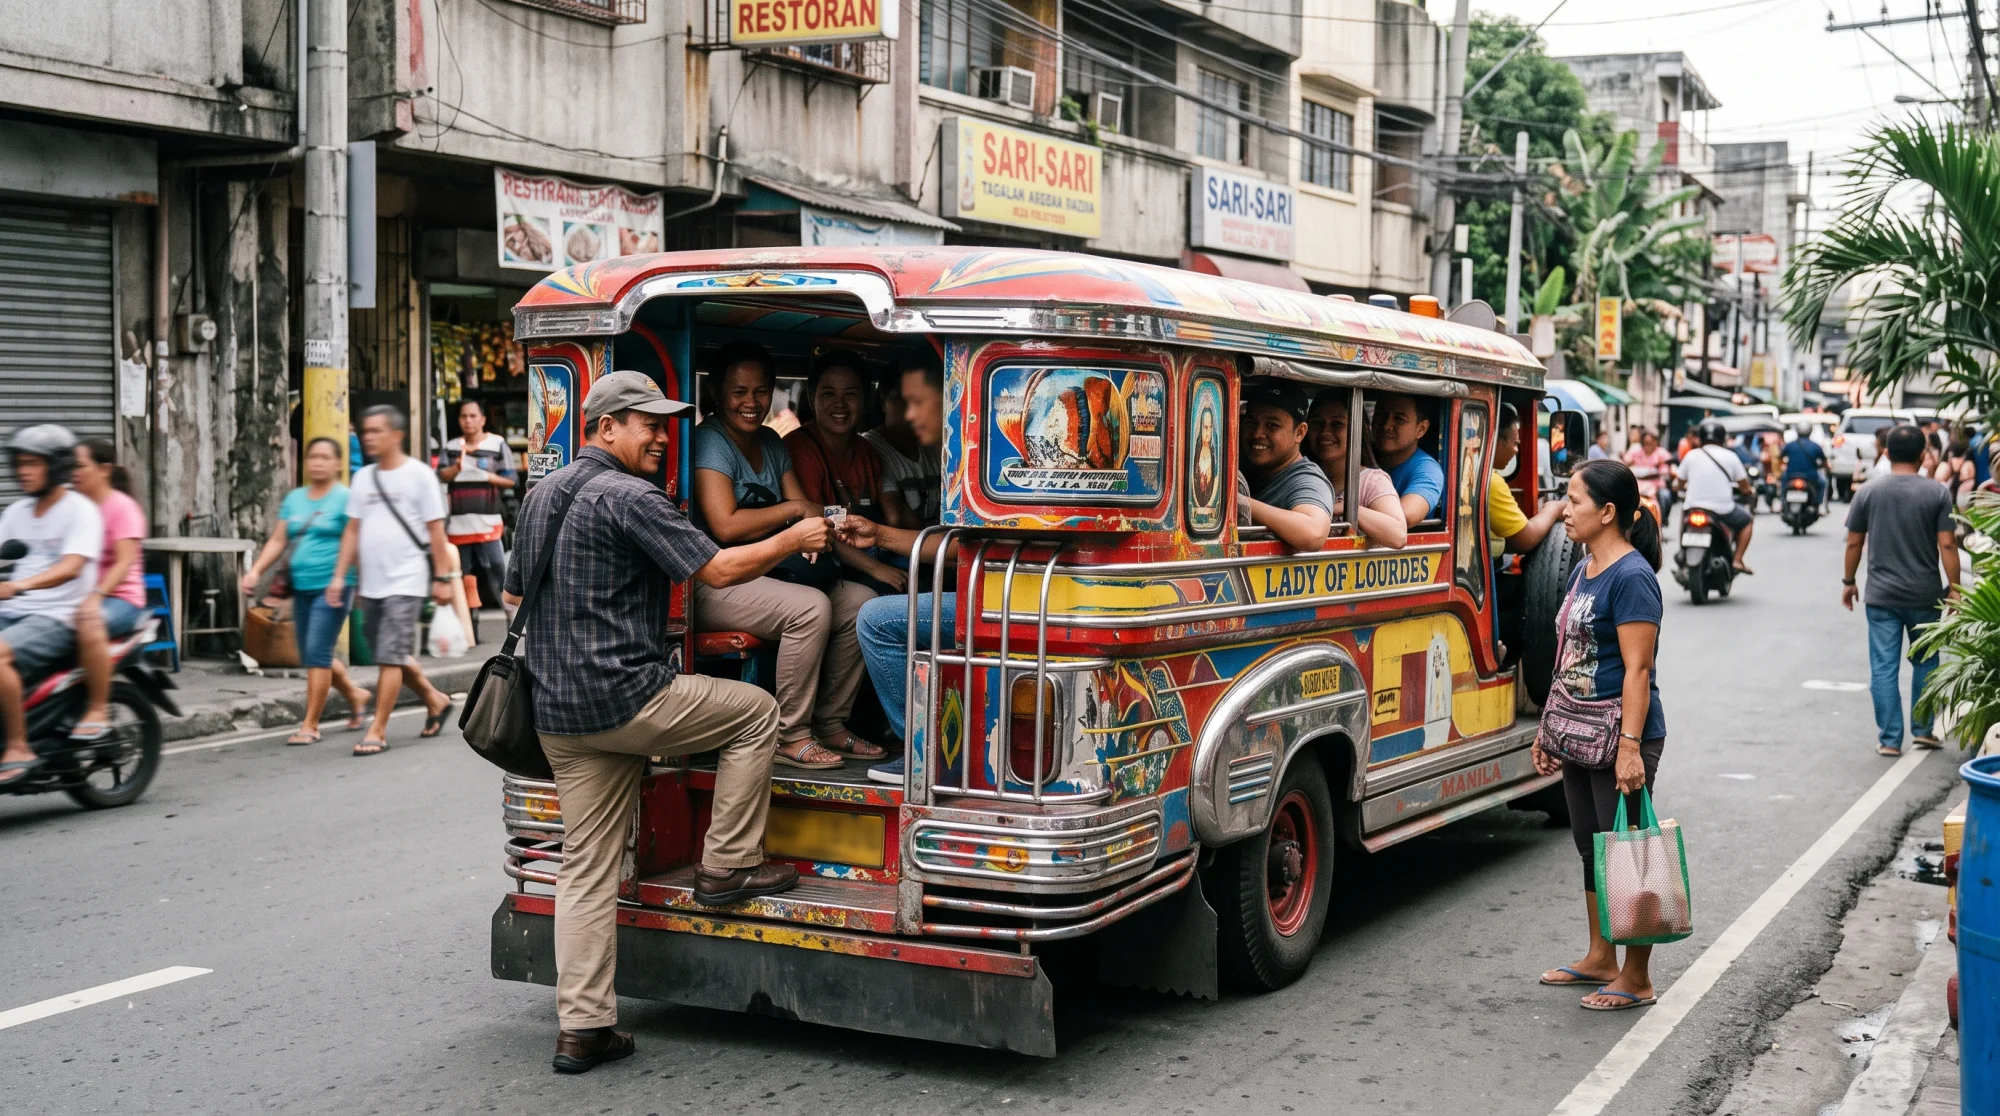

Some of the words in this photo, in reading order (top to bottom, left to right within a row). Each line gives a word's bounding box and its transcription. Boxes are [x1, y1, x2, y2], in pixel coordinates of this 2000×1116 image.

[738, 0, 876, 34] RESTORAN
[983, 132, 1093, 194] SARI-SARI
[1207, 176, 1292, 225] SARI-SARI
[1264, 564, 1319, 599] LADY
[1324, 562, 1348, 593] OF
[1354, 555, 1429, 590] LOURDES
[1441, 762, 1502, 799] MANILA
